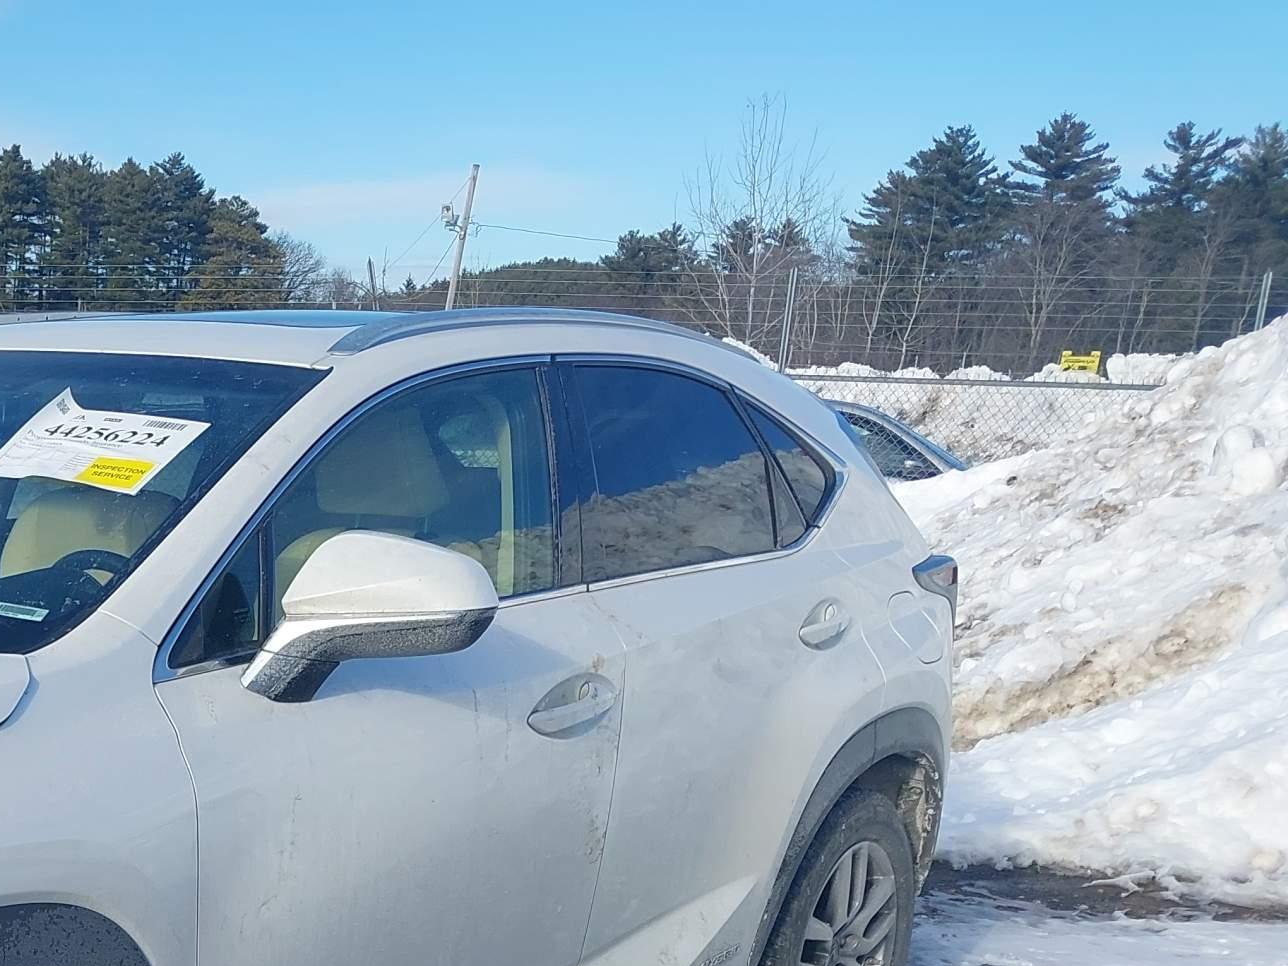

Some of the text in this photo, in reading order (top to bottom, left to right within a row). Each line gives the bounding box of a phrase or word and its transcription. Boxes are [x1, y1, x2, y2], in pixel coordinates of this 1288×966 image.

[44, 423, 171, 447] 44256224
[91, 463, 146, 475] INSPECTION
[92, 470, 133, 481] SERVICE
